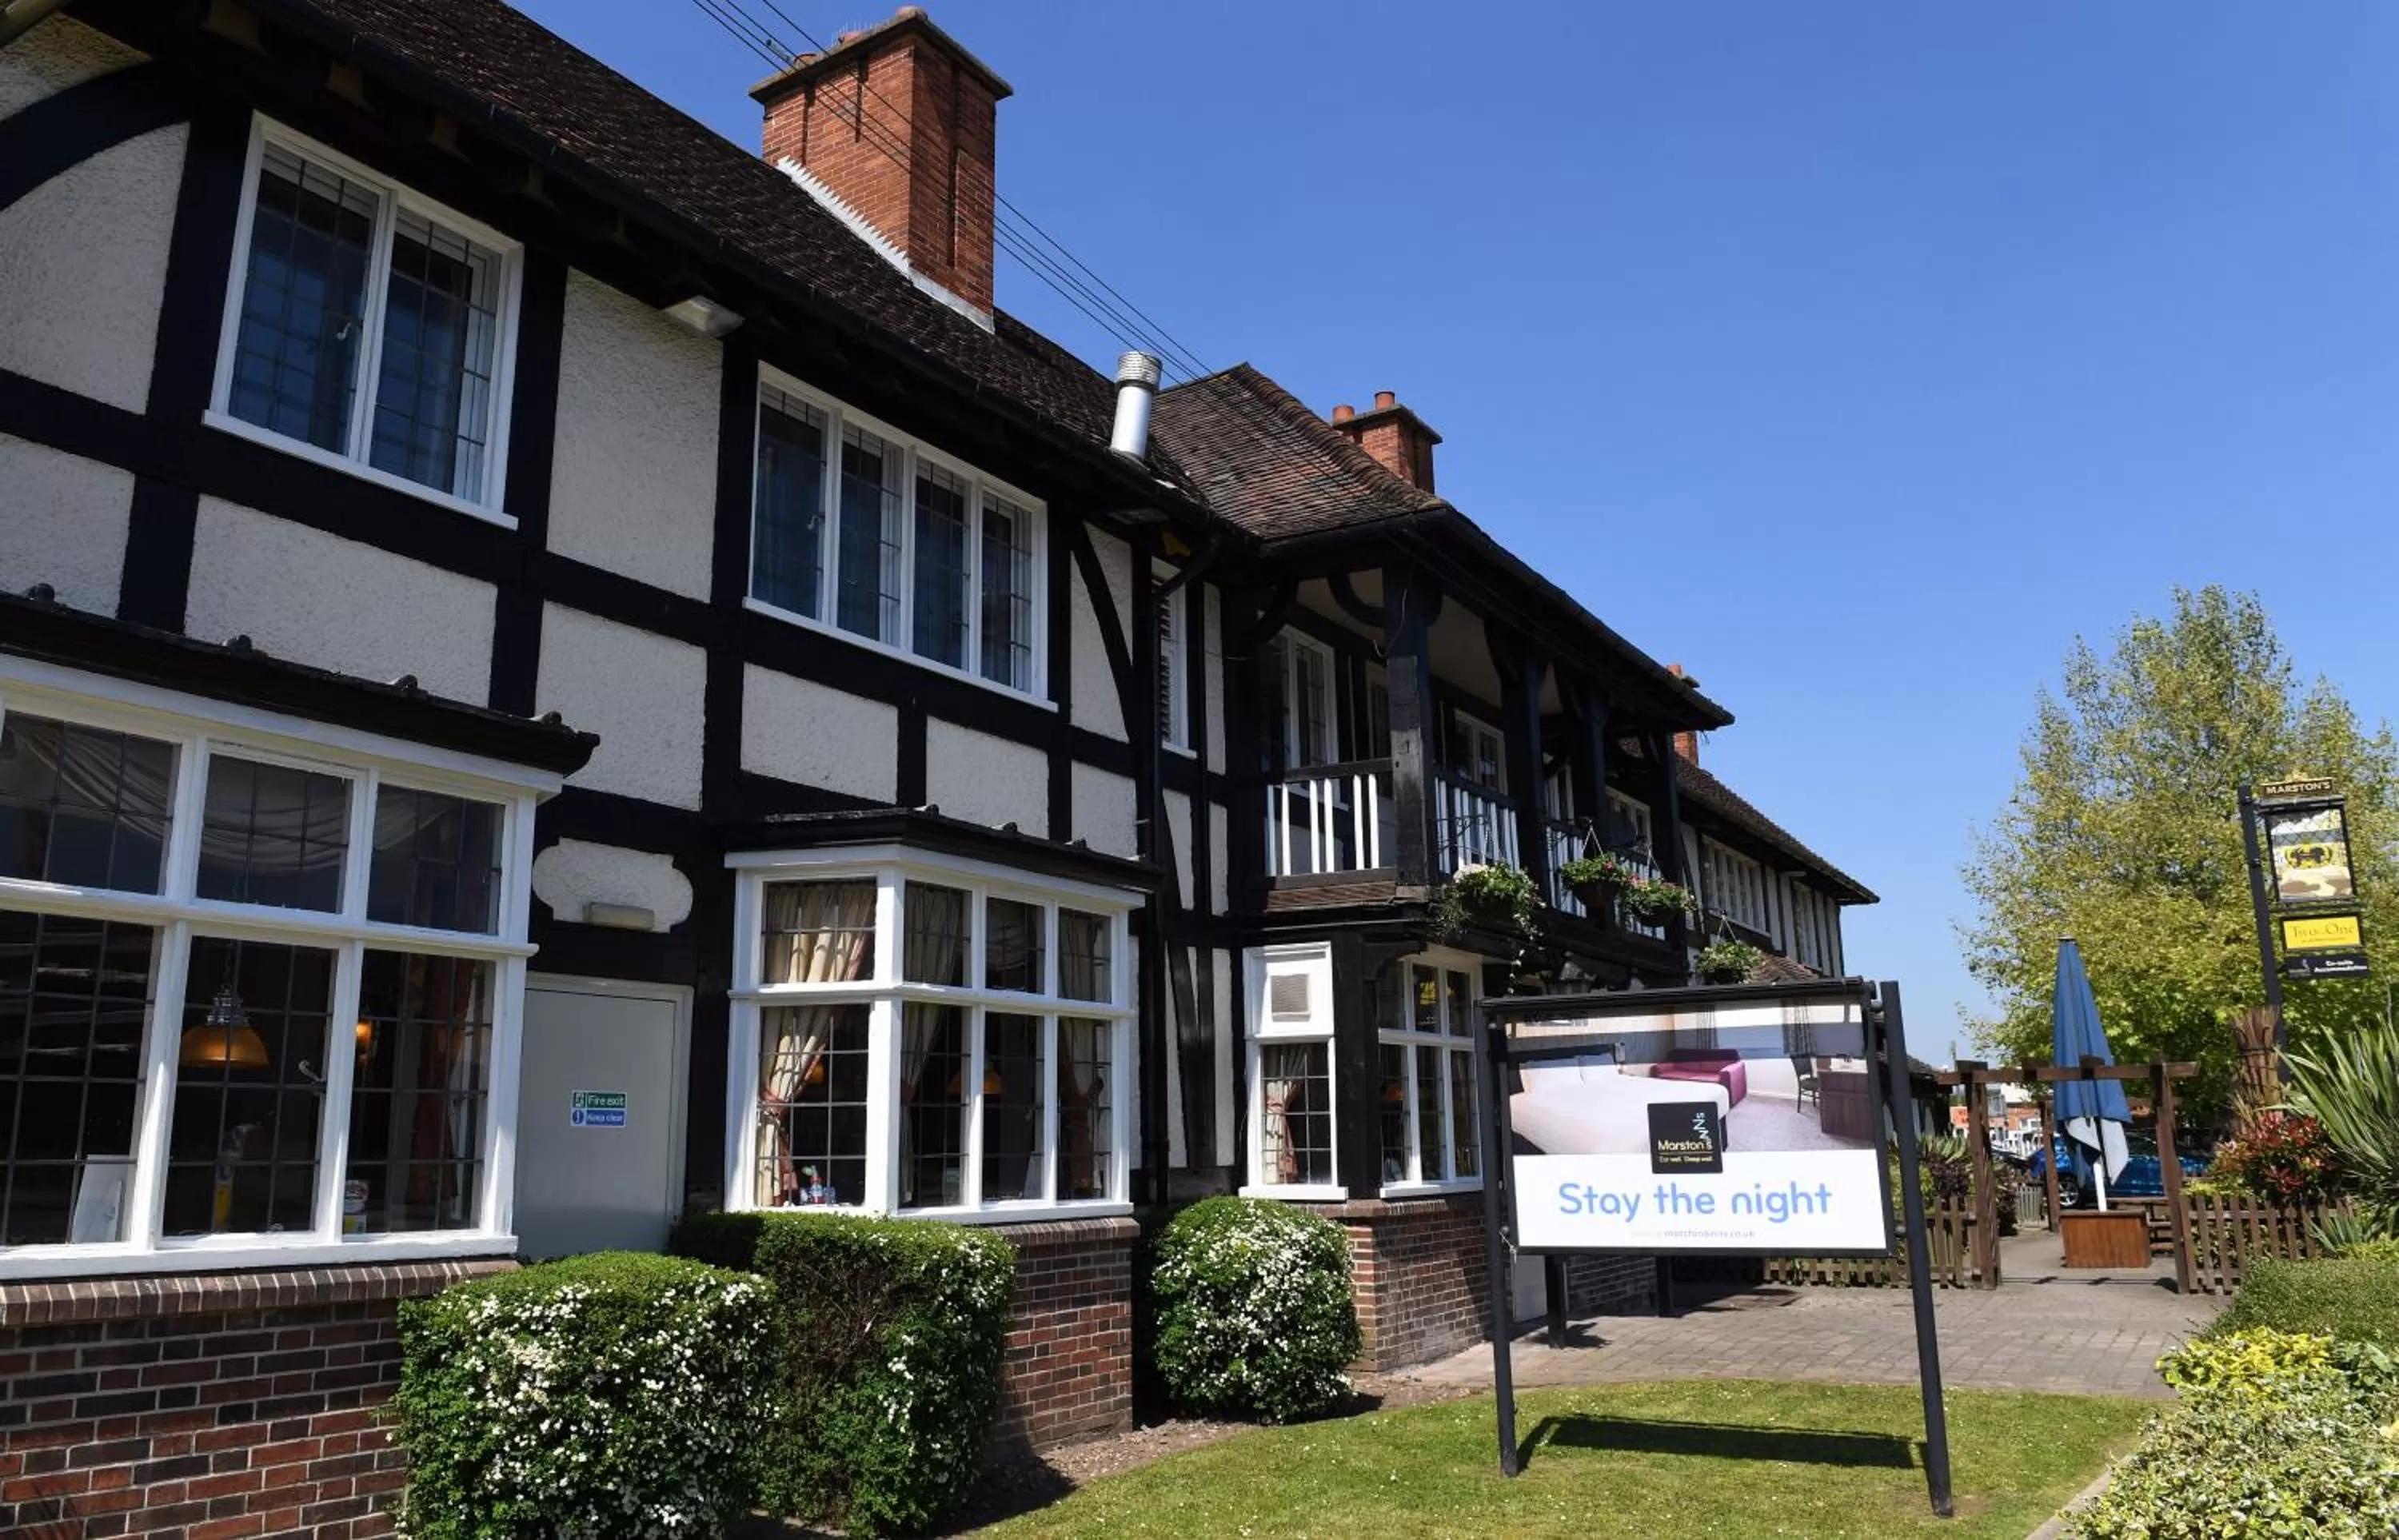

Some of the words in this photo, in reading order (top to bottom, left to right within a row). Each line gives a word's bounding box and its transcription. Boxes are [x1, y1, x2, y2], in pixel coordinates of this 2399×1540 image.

[2265, 781, 2331, 794] MARSTON'S
[588, 1095, 605, 1106] Fire
[607, 1095, 625, 1106] exit
[1558, 1182, 1641, 1223] Stay
[1653, 1182, 1716, 1215] the
[1730, 1180, 1833, 1223] night
